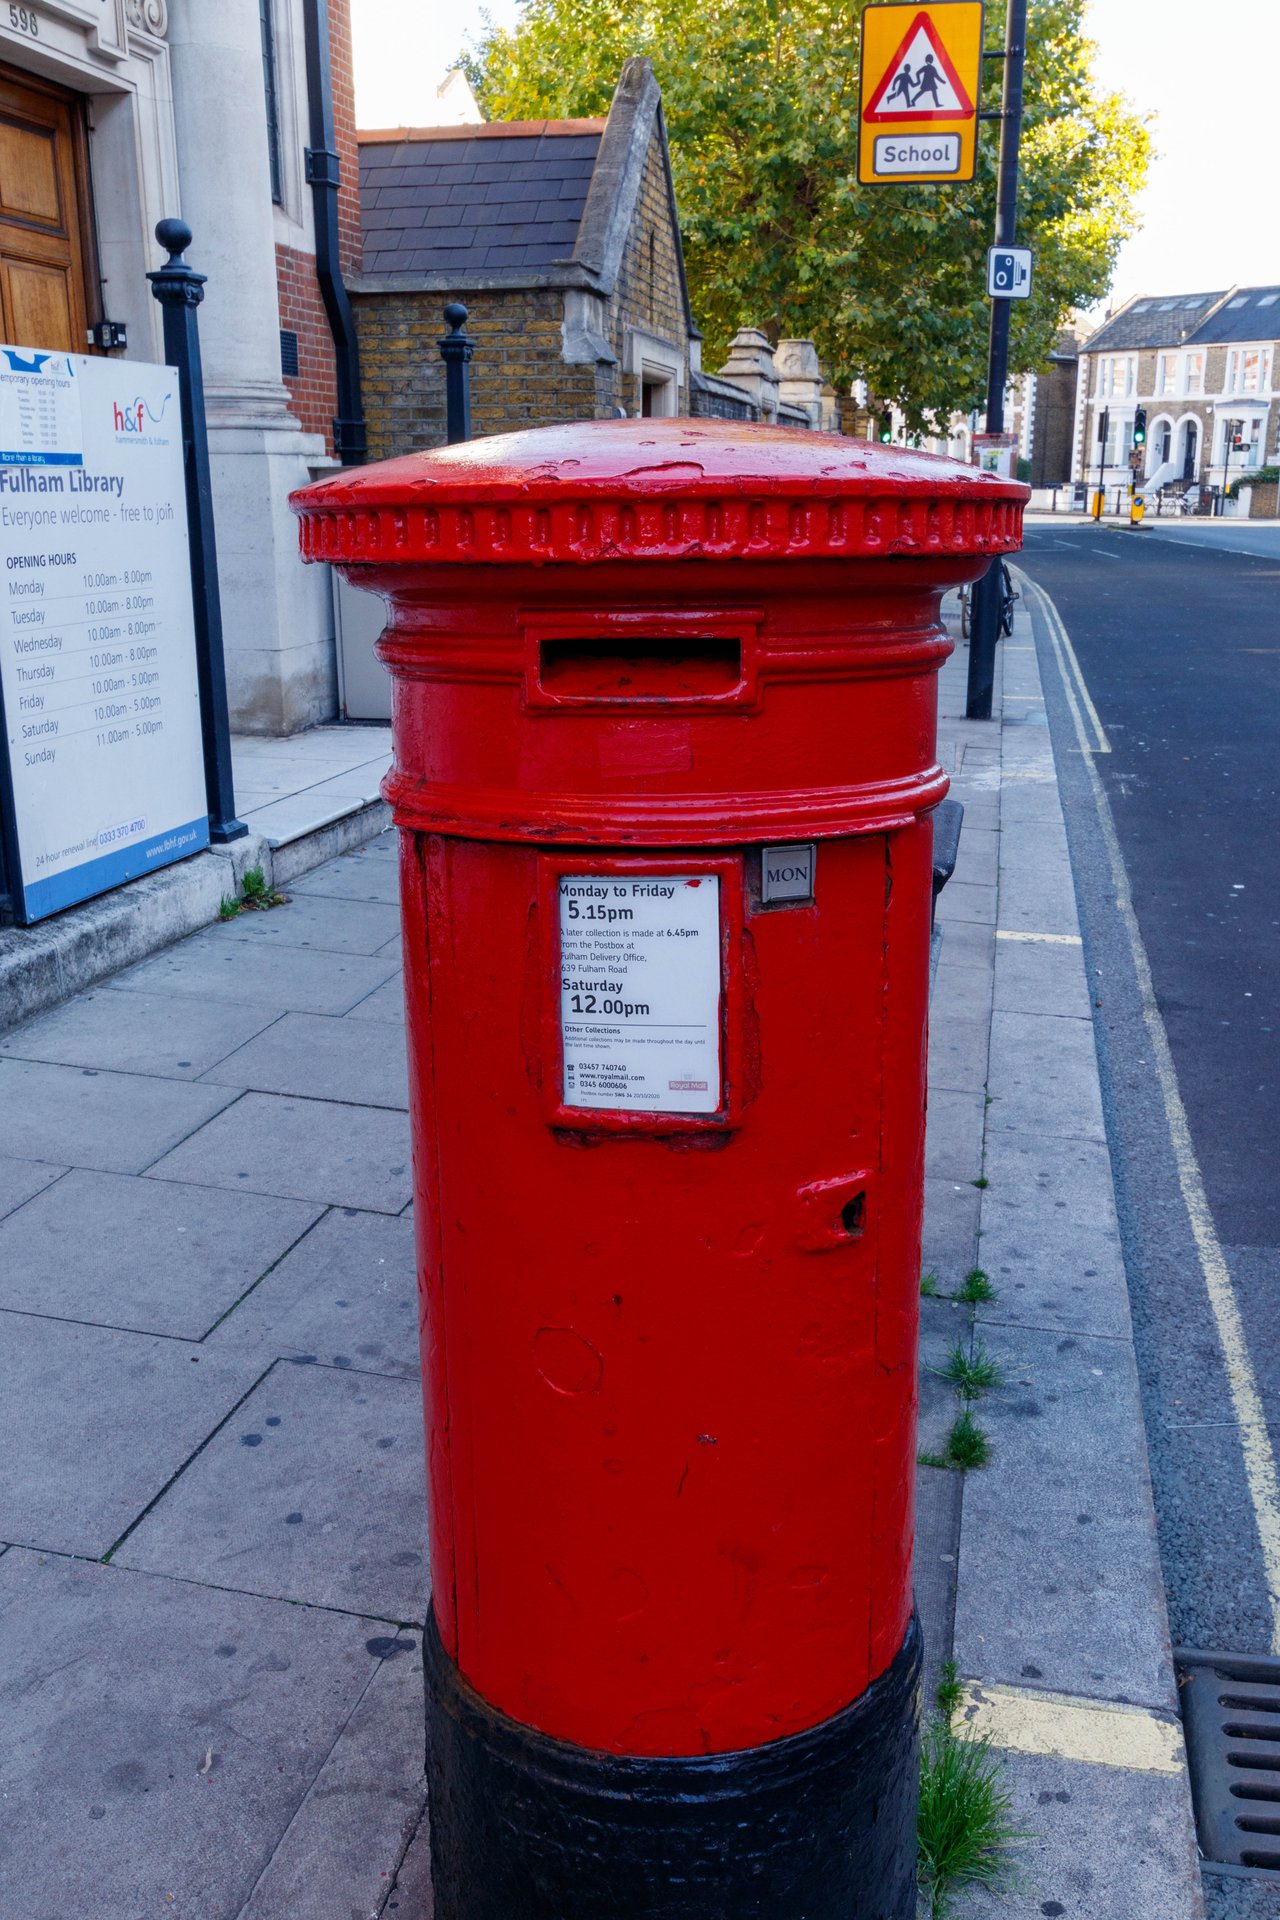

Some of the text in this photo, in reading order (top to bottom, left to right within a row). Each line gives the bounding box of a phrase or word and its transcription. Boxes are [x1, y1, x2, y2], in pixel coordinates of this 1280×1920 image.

[10, 4, 38, 36] 598
[883, 144, 950, 162] School
[0, 374, 30, 387] emporary
[31, 376, 56, 389] opening
[113, 402, 144, 432] h&f
[0, 468, 124, 498] Fulham Library
[2, 506, 57, 530] Everyone
[60, 504, 110, 524] welcome
[120, 503, 140, 522] free
[143, 505, 154, 521] to
[156, 503, 174, 526] join
[6, 552, 77, 570] OPENING HOURS
[8, 579, 44, 596] Monday
[84, 573, 117, 588] 10.00am
[124, 570, 152, 584] 8.00pm
[11, 608, 46, 625] Tuesday
[86, 600, 119, 615] 10.00am
[126, 596, 154, 611] 8.00pm
[14, 634, 62, 654] Wednesday
[88, 626, 121, 642] 10.00am
[128, 621, 156, 636] 8.00pm
[16, 664, 55, 682] Thursday
[90, 652, 123, 668] 10.00am
[130, 646, 158, 662] 8.00pm
[19, 694, 44, 710] Friday
[92, 678, 126, 695] 10.00am
[132, 671, 160, 686] 5.00pm
[22, 720, 59, 739] Saturday
[94, 704, 127, 720] 10.00am
[134, 696, 161, 712] 5.00pm
[24, 748, 56, 766] Sunday
[96, 730, 130, 747] 11.00am
[136, 720, 163, 736] 5.00pm
[36, 855, 45, 868] 24
[45, 850, 60, 863] hour
[62, 840, 86, 857] renewal
[100, 830, 116, 844] 0333
[116, 826, 128, 839] 370
[130, 819, 146, 832] 4700
[145, 830, 197, 858] www.lbhf.gov.uk
[768, 866, 808, 883] MON
[560, 884, 675, 900] Monday to Friday
[568, 900, 634, 922] 5.15pm
[566, 928, 583, 936] later
[585, 928, 621, 937] collection
[622, 929, 630, 937] is
[632, 929, 654, 937] made
[666, 928, 699, 938] 6.45pm
[594, 941, 624, 950] Postbox
[626, 942, 634, 950] at
[560, 952, 648, 963] Fulham Delivery Office,
[561, 964, 628, 974] 639 Fulham Road
[562, 978, 623, 994] Saturday
[570, 994, 650, 1018] 12.00pm
[585, 1026, 621, 1034] Collections
[578, 1062, 626, 1072] 03457 740740
[579, 1074, 646, 1082] www.royalmail.com
[580, 1080, 628, 1090] 0345 6000606
[670, 1082, 690, 1090] Royal
